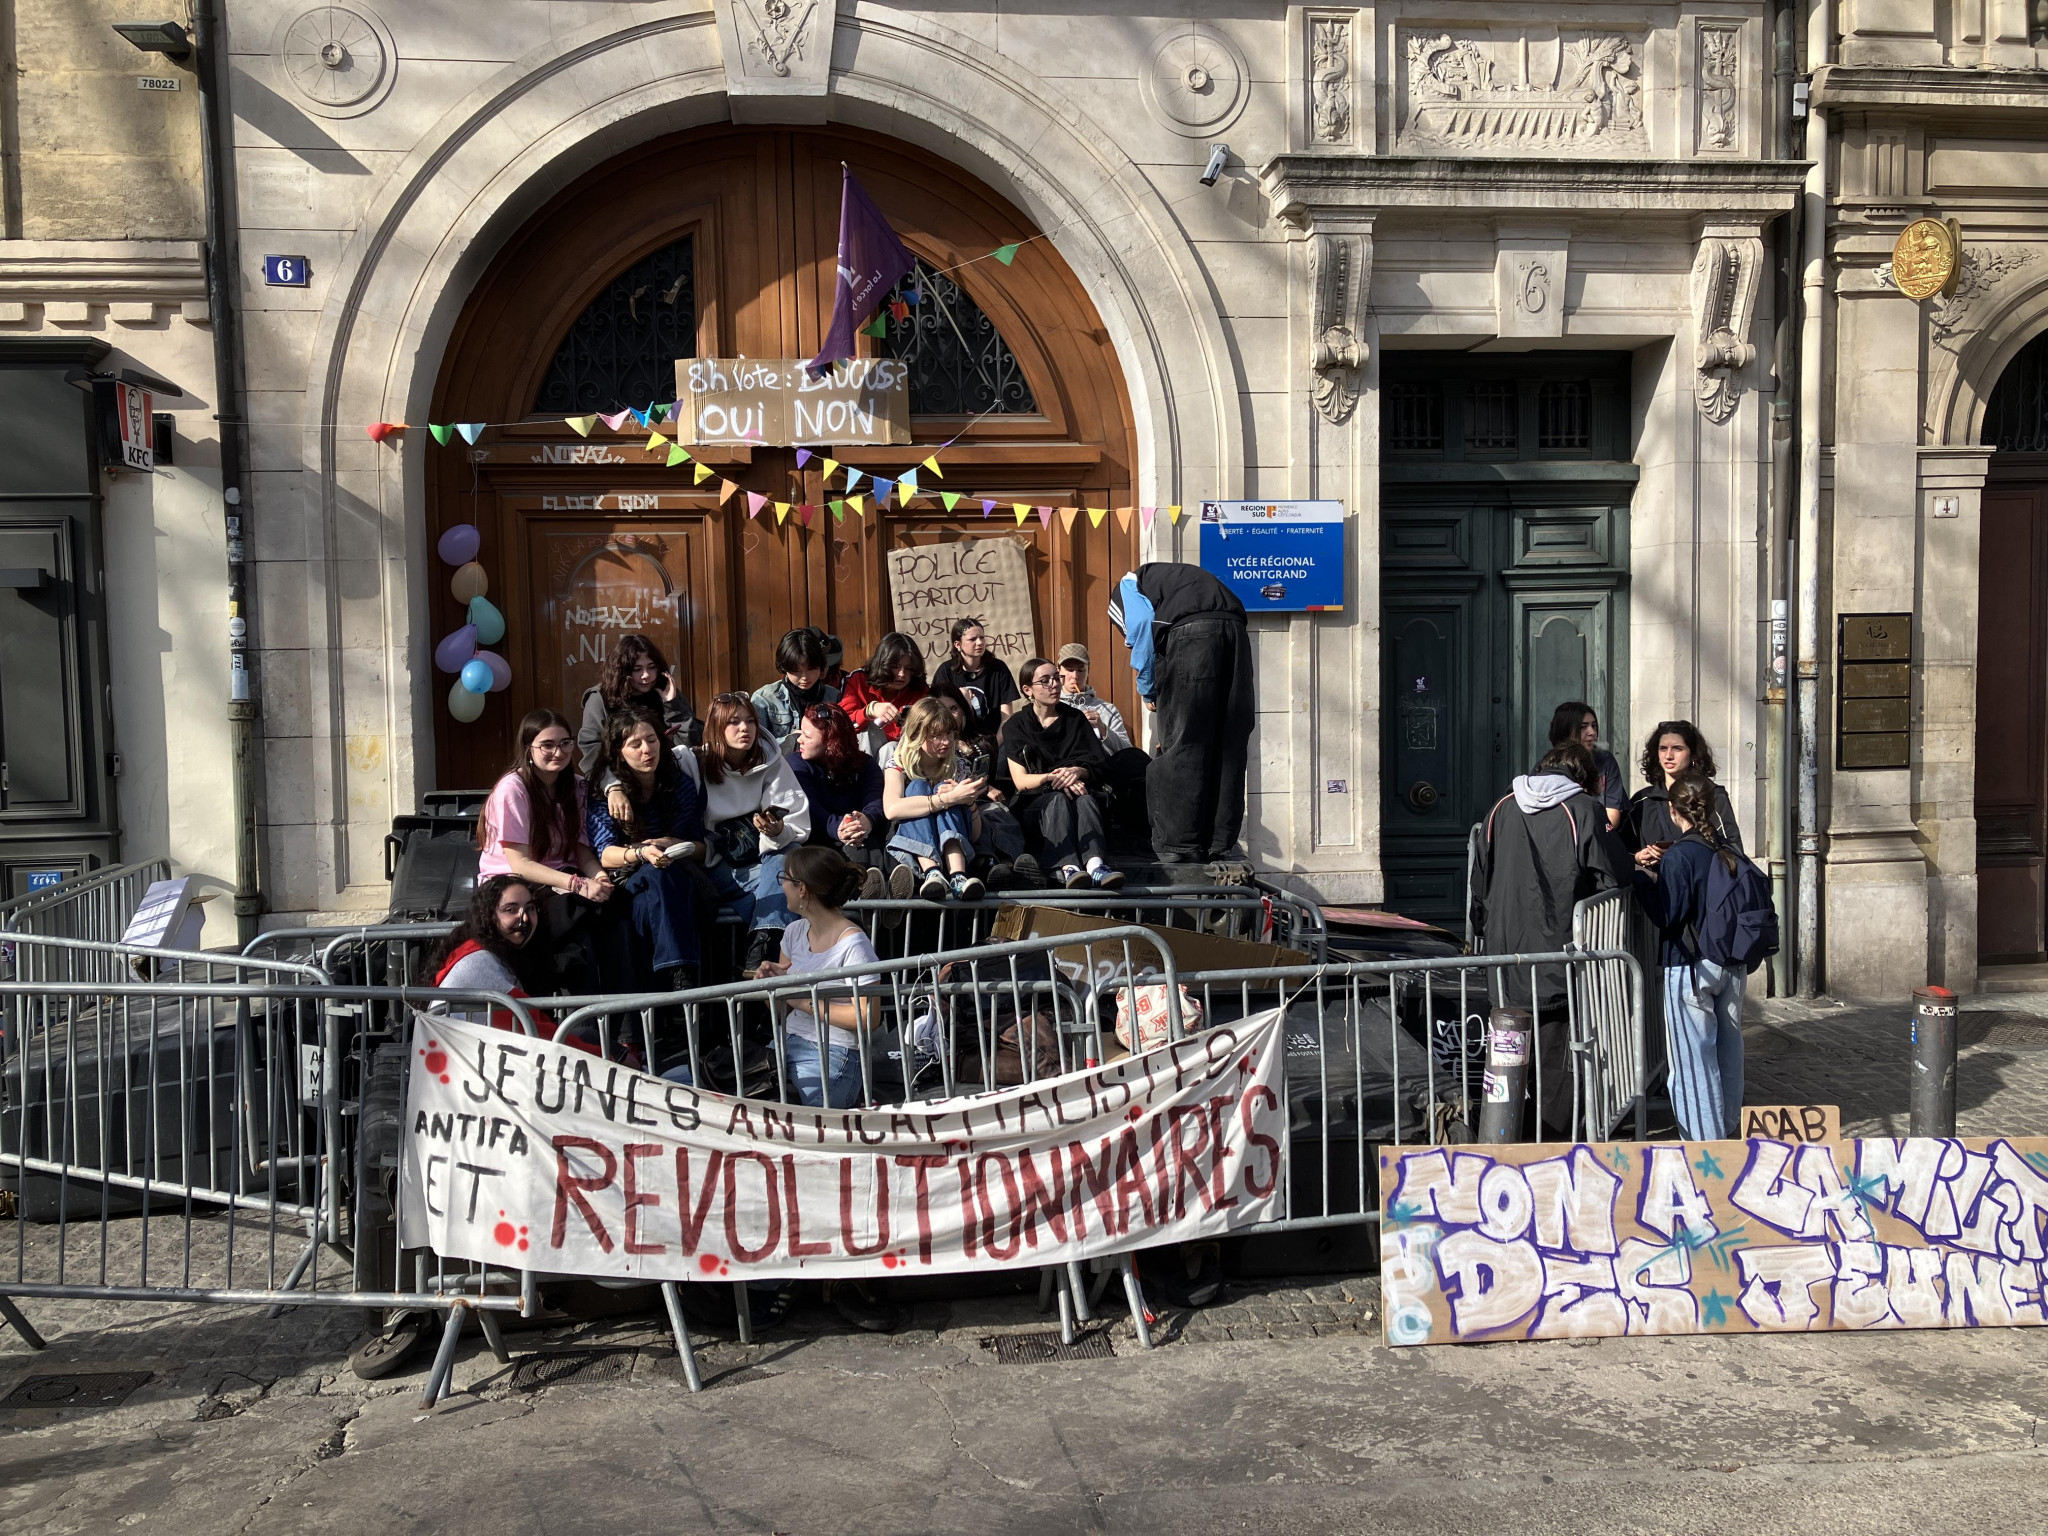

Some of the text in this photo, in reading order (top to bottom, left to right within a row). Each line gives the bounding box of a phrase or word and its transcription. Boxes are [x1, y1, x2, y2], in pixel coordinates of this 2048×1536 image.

[142, 79, 175, 89] 78022
[277, 259, 293, 281] 6
[688, 360, 728, 392] 8h
[794, 399, 875, 439] NON
[128, 446, 149, 467] KFC
[1240, 504, 1266, 512] RÉGION
[1219, 526, 1324, 535] LBERTÉ ÉGALITÉ FRATERNITÉ
[1227, 555, 1316, 567] LYCÉE RÉGIONAL
[1233, 570, 1307, 580] MONTGRAND
[897, 582, 1005, 612] PARTOUT
[902, 612, 990, 637] JUSTE
[463, 1039, 701, 1131] JEUNES
[414, 1110, 529, 1156] ANTIFA
[1746, 1106, 1828, 1142] ACAB
[427, 1085, 1279, 1265] ET REVOLUTIONNAIRES
[1388, 1144, 1623, 1256] NON
